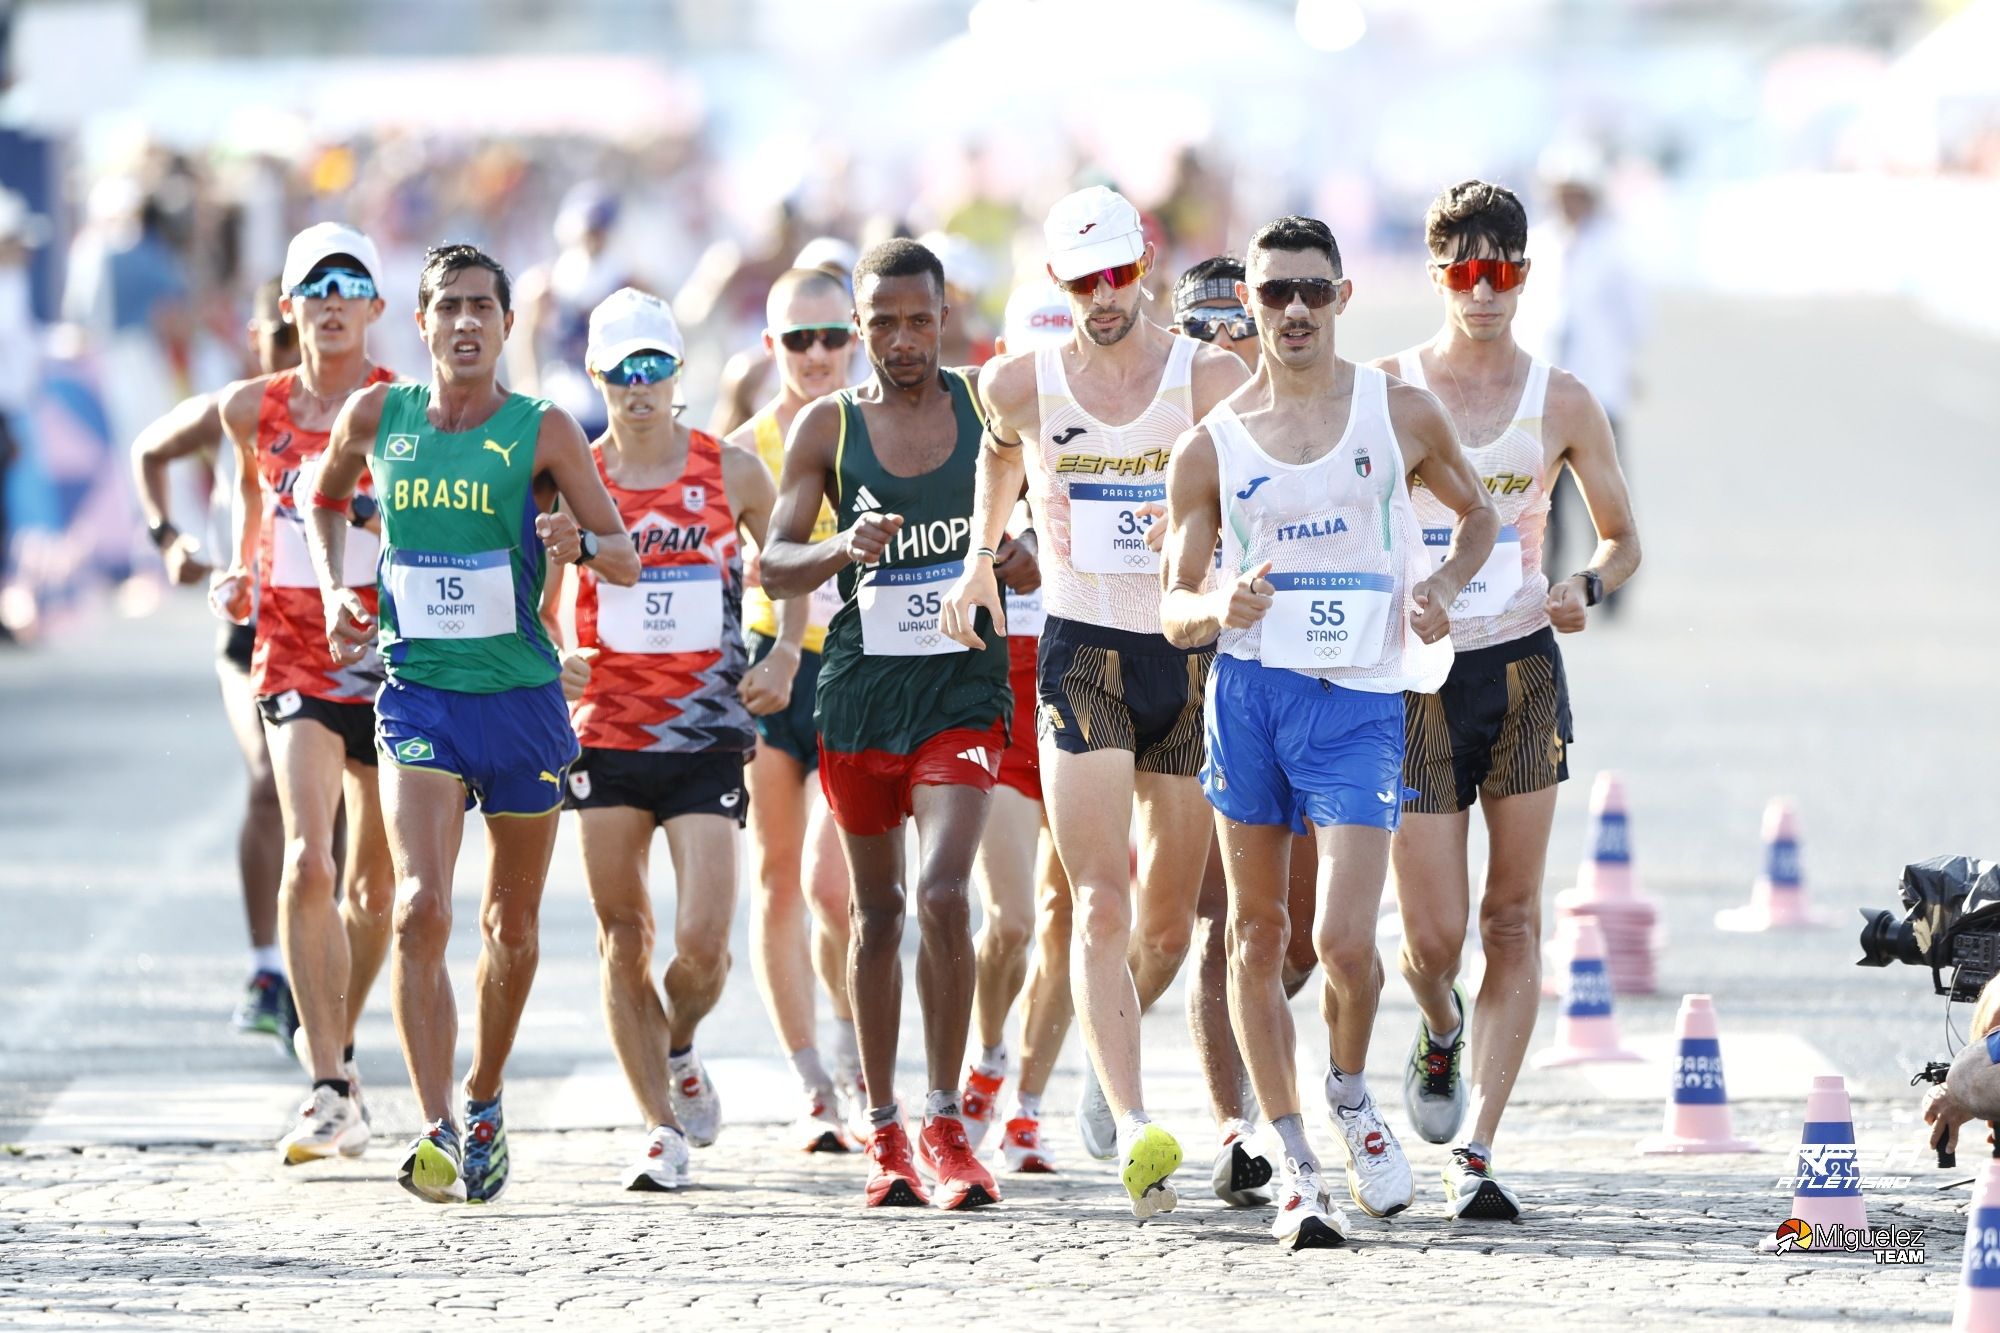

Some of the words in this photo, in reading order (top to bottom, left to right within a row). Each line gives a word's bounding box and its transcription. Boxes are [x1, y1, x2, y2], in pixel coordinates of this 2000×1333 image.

[1031, 315, 1072, 327] CHIN
[395, 478, 495, 515] BRASIL
[1137, 488, 1164, 498] 2024
[1277, 517, 1348, 541] ITALIA
[631, 531, 706, 554] APAN
[1423, 533, 1448, 541] PARI
[1113, 538, 1150, 550] MART
[925, 568, 953, 578] 2024
[1330, 577, 1361, 586] 2024
[436, 577, 464, 600] 15
[427, 604, 475, 615] BONFIM
[645, 592, 673, 615] 57
[907, 591, 941, 617] 35
[1006, 600, 1040, 611] HANG
[1309, 600, 1345, 626] 55
[643, 619, 676, 631] IKEDA
[898, 618, 939, 632] WAKU
[1306, 630, 1348, 642] STANO
[1969, 1249, 2000, 1270] 20
